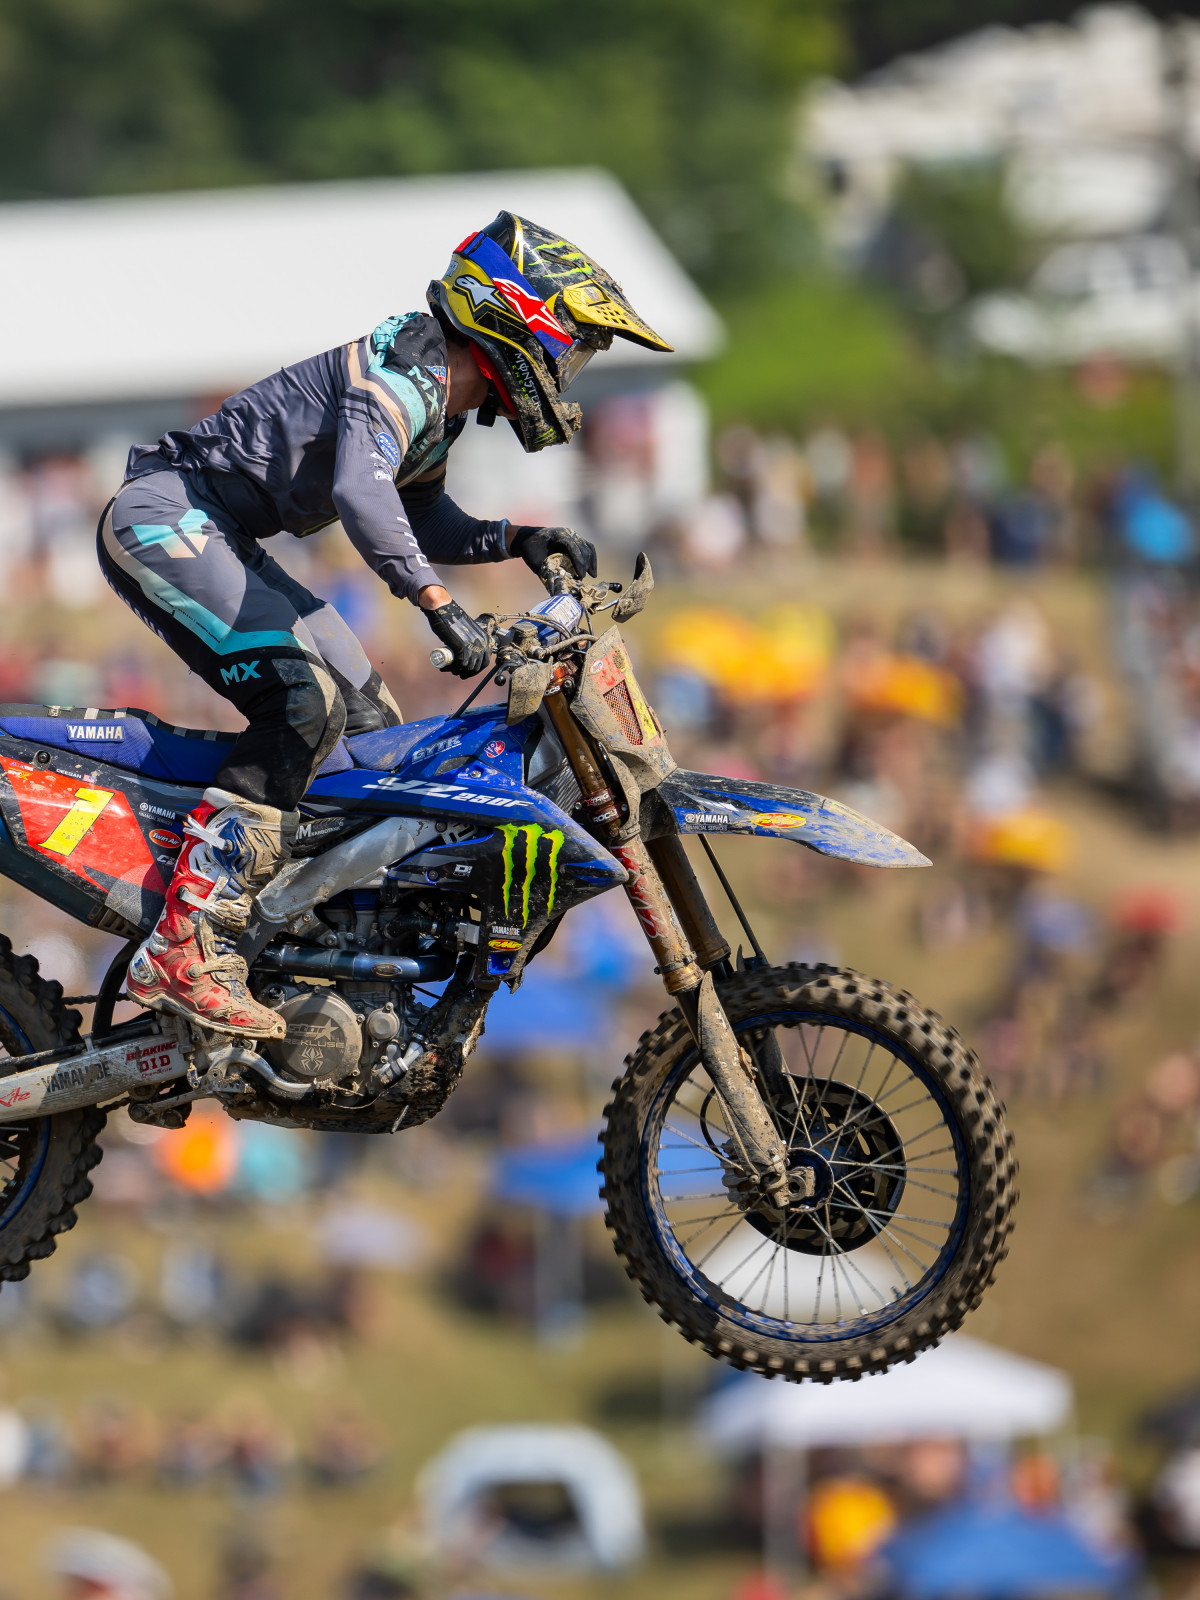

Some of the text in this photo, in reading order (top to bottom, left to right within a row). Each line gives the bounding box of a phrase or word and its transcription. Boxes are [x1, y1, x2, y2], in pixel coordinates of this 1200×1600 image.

[220, 660, 262, 686] MX
[68, 725, 123, 740] YAMAHA
[148, 804, 176, 820] YAMAHA
[695, 814, 729, 824] YAMAHA
[36, 787, 116, 857] 1
[152, 831, 180, 845] Twin Air
[282, 1038, 346, 1049] REKLUSE
